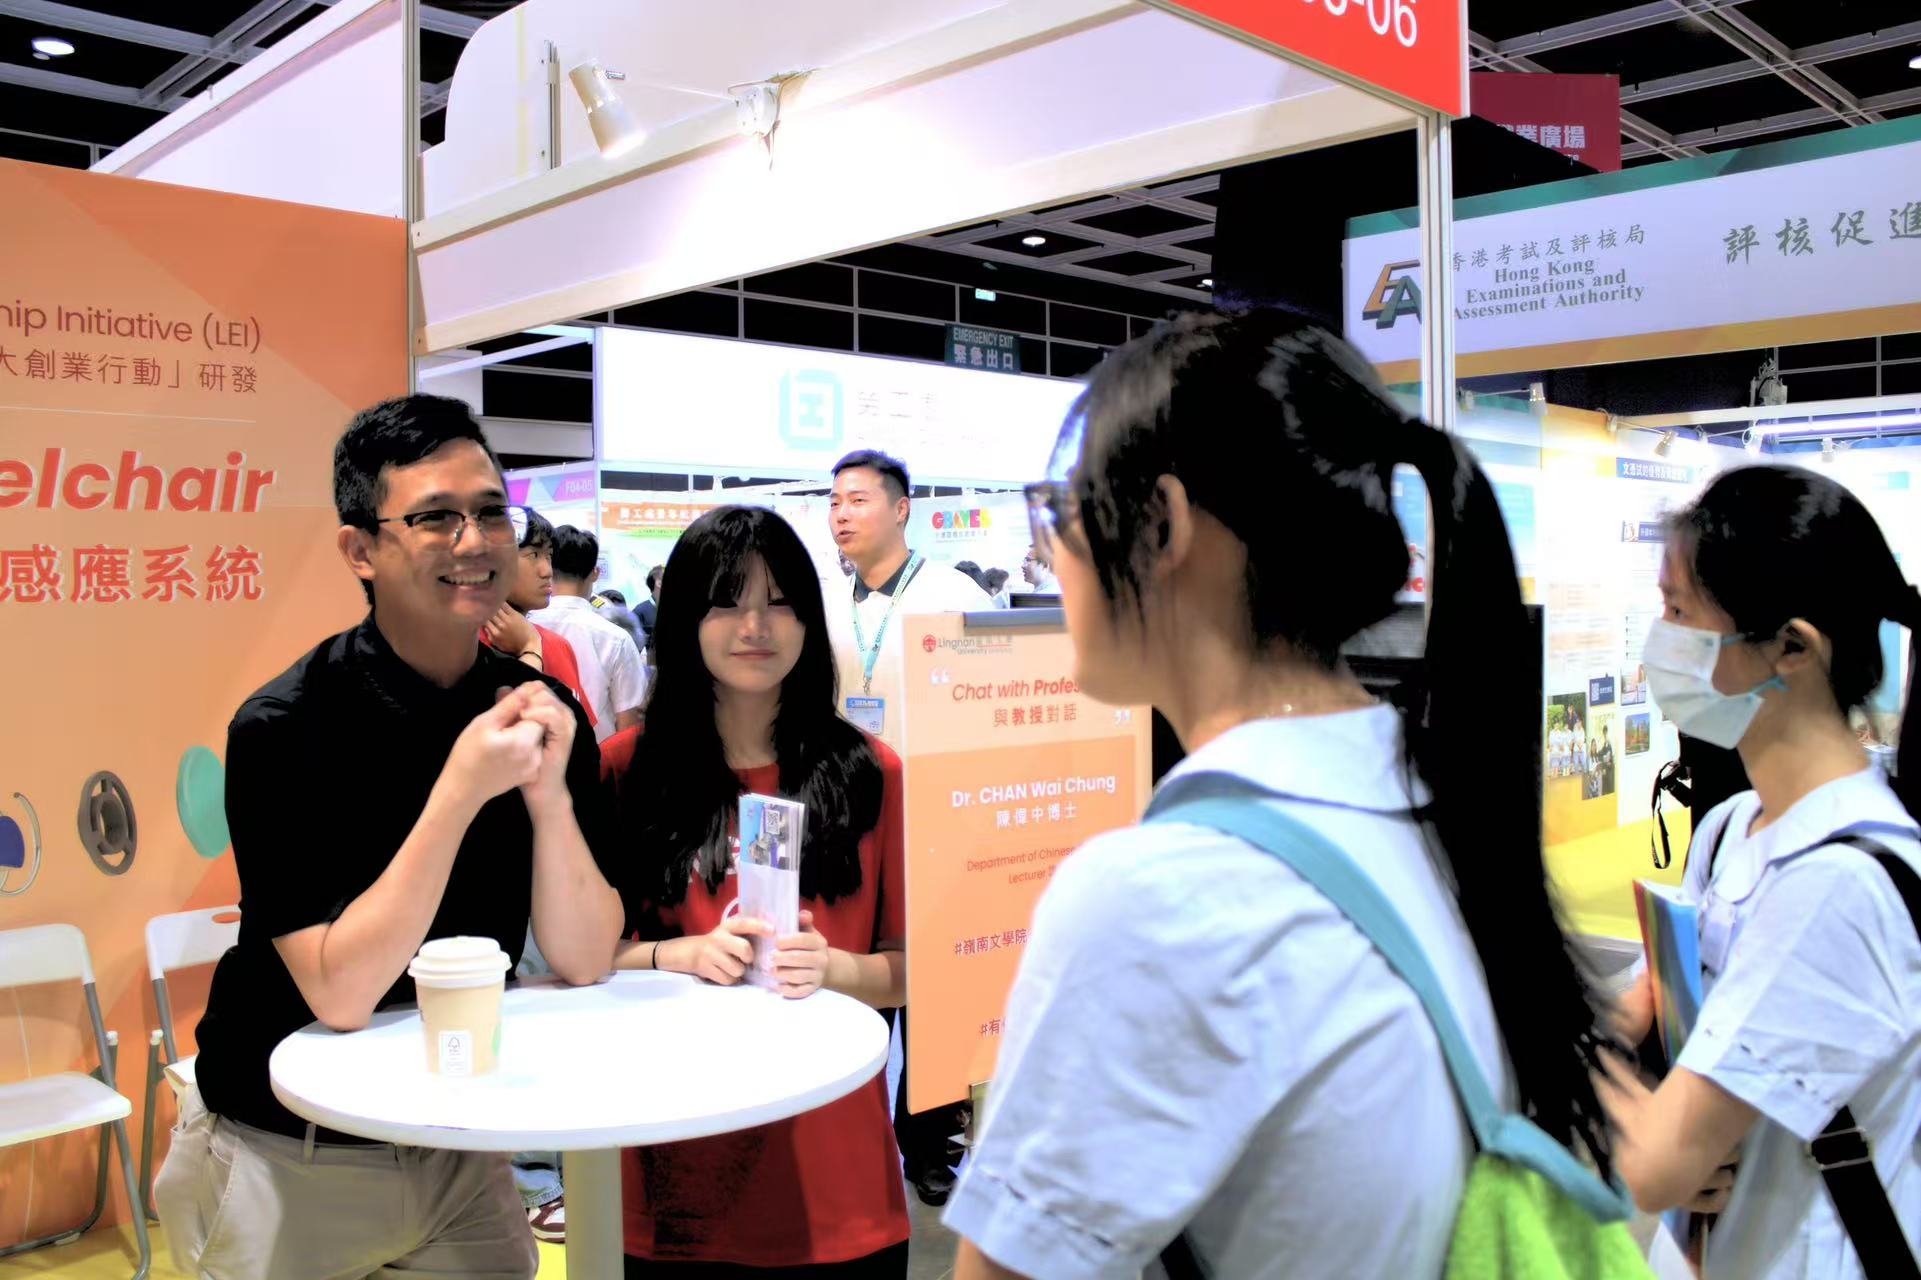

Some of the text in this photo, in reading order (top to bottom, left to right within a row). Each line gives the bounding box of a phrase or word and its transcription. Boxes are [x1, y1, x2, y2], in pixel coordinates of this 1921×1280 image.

[1497, 124, 1586, 149] 業廣場
[1723, 201, 1921, 264] 評核促進
[1495, 258, 1594, 284] Hong Kong
[1466, 268, 1627, 304] Examinations and
[1554, 285, 1645, 309] Authority
[57, 305, 193, 343] Initiative
[203, 312, 261, 354] (LEI)
[953, 327, 1014, 348] EMERGENCY EXIT
[953, 344, 1014, 370] 緊急出口
[0, 544, 263, 602] 感應系統
[938, 636, 975, 653] Lingnan
[952, 683, 992, 701] Chat
[997, 681, 1030, 699] with
[993, 703, 1077, 728] 與教授對話
[952, 775, 1116, 807] Dr. CHAN Wai Chung
[996, 802, 1077, 828] 陳偉中博士
[967, 851, 1026, 872] Department
[1028, 850, 1037, 861] of
[1009, 870, 1046, 884] Lecturer
[980, 1017, 1006, 1036] #有
